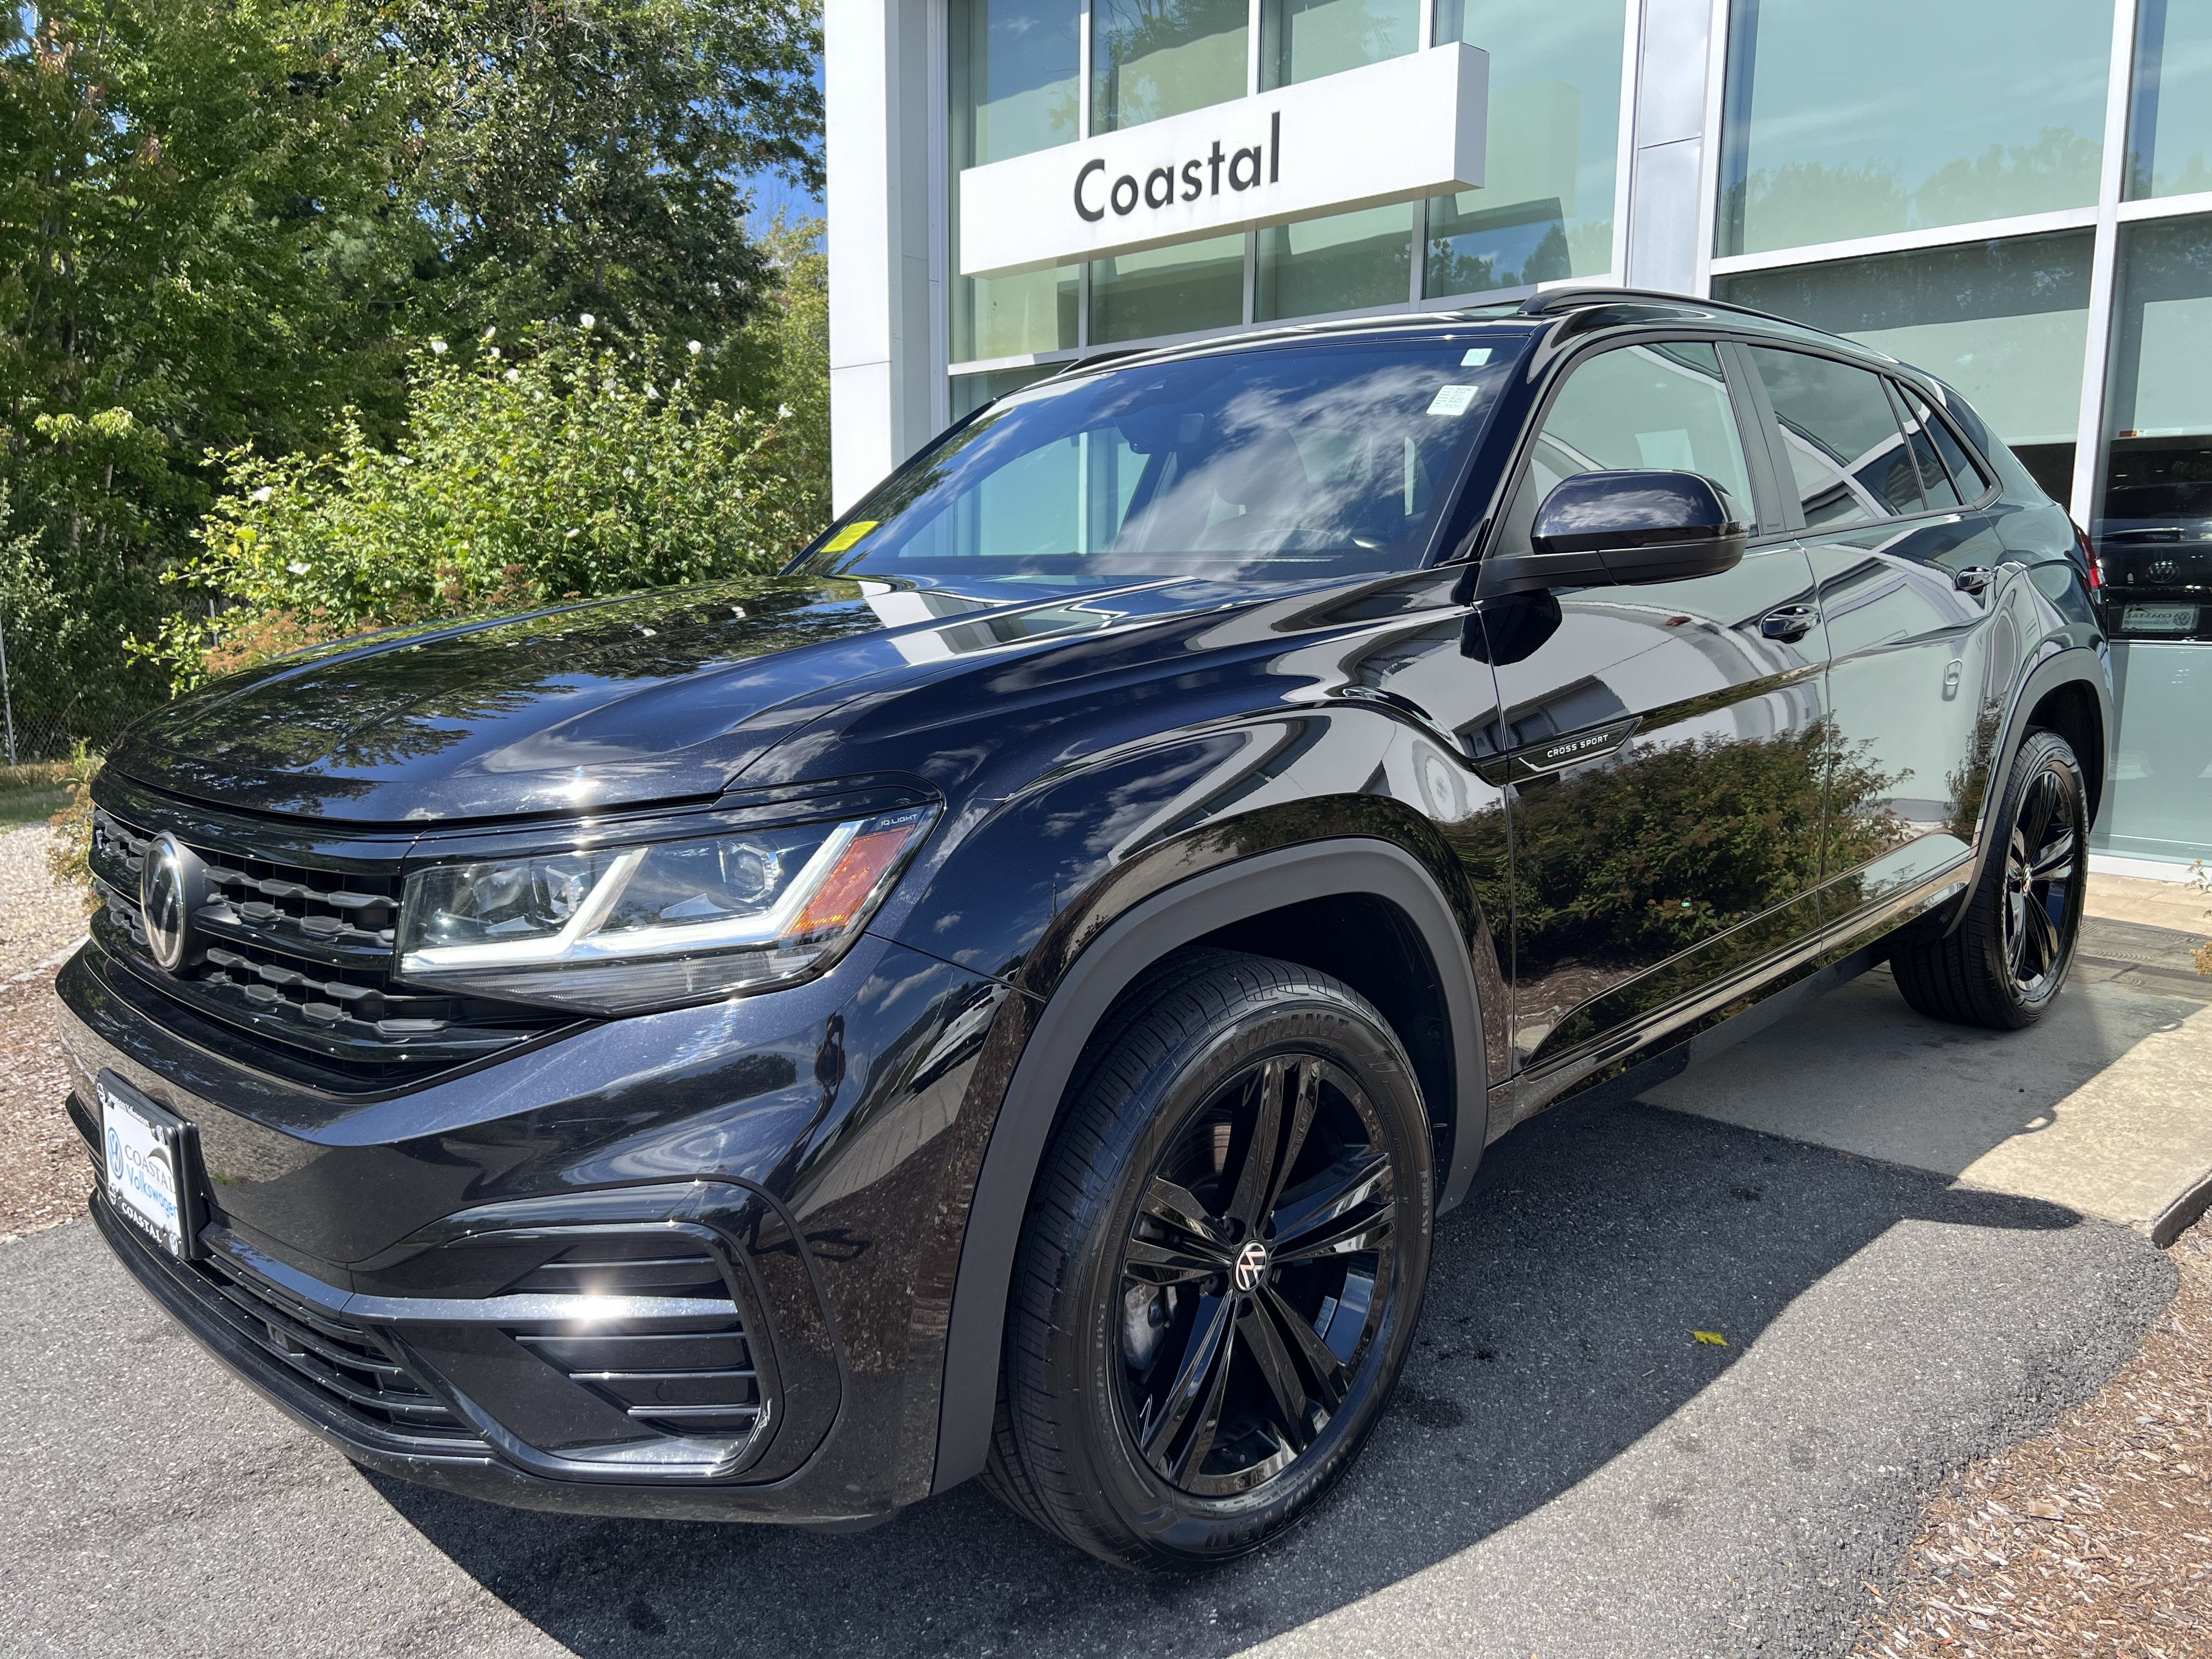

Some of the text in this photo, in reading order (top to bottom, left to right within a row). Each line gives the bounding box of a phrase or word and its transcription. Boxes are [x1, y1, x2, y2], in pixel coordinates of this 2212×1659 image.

[1074, 110, 1280, 222] Coastal
[1547, 735, 1609, 758] CROSS SPORT
[881, 814, 918, 826] IQ.LIGHT
[1201, 1012, 1350, 1090] ASSURANCE
[125, 1144, 176, 1194] COASTAL
[121, 1202, 162, 1243] COASTAL
[1418, 1169, 1429, 1238] FINESSE
